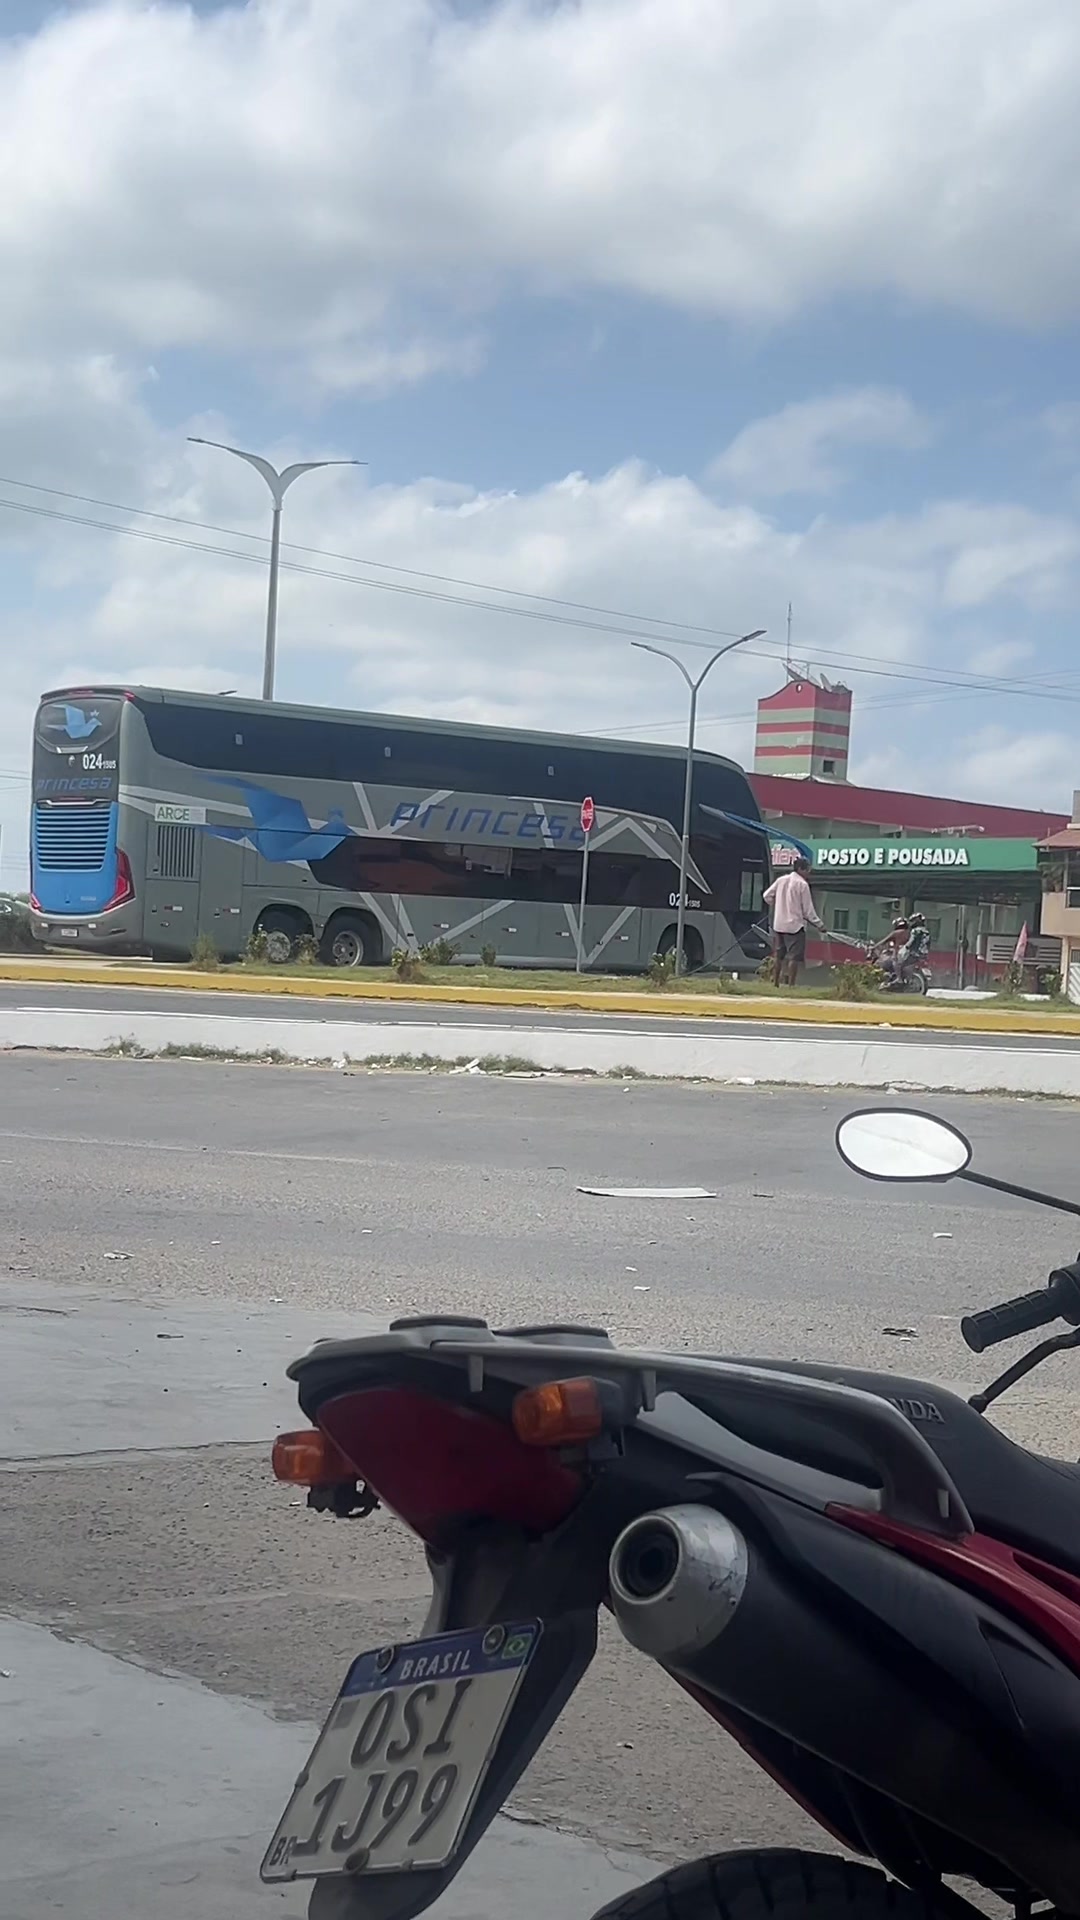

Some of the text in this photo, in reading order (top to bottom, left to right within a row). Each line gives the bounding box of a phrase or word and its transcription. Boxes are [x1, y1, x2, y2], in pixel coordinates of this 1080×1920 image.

[82, 753, 102, 770] 024
[157, 806, 190, 822] ARCE
[817, 847, 870, 865] POSTO
[874, 847, 884, 864] E
[887, 847, 968, 865] POUSADA
[888, 1397, 946, 1424] NDA
[399, 1649, 471, 1681] BRASIL
[350, 1678, 473, 1769] OSI
[290, 1763, 459, 1857] 1J99
